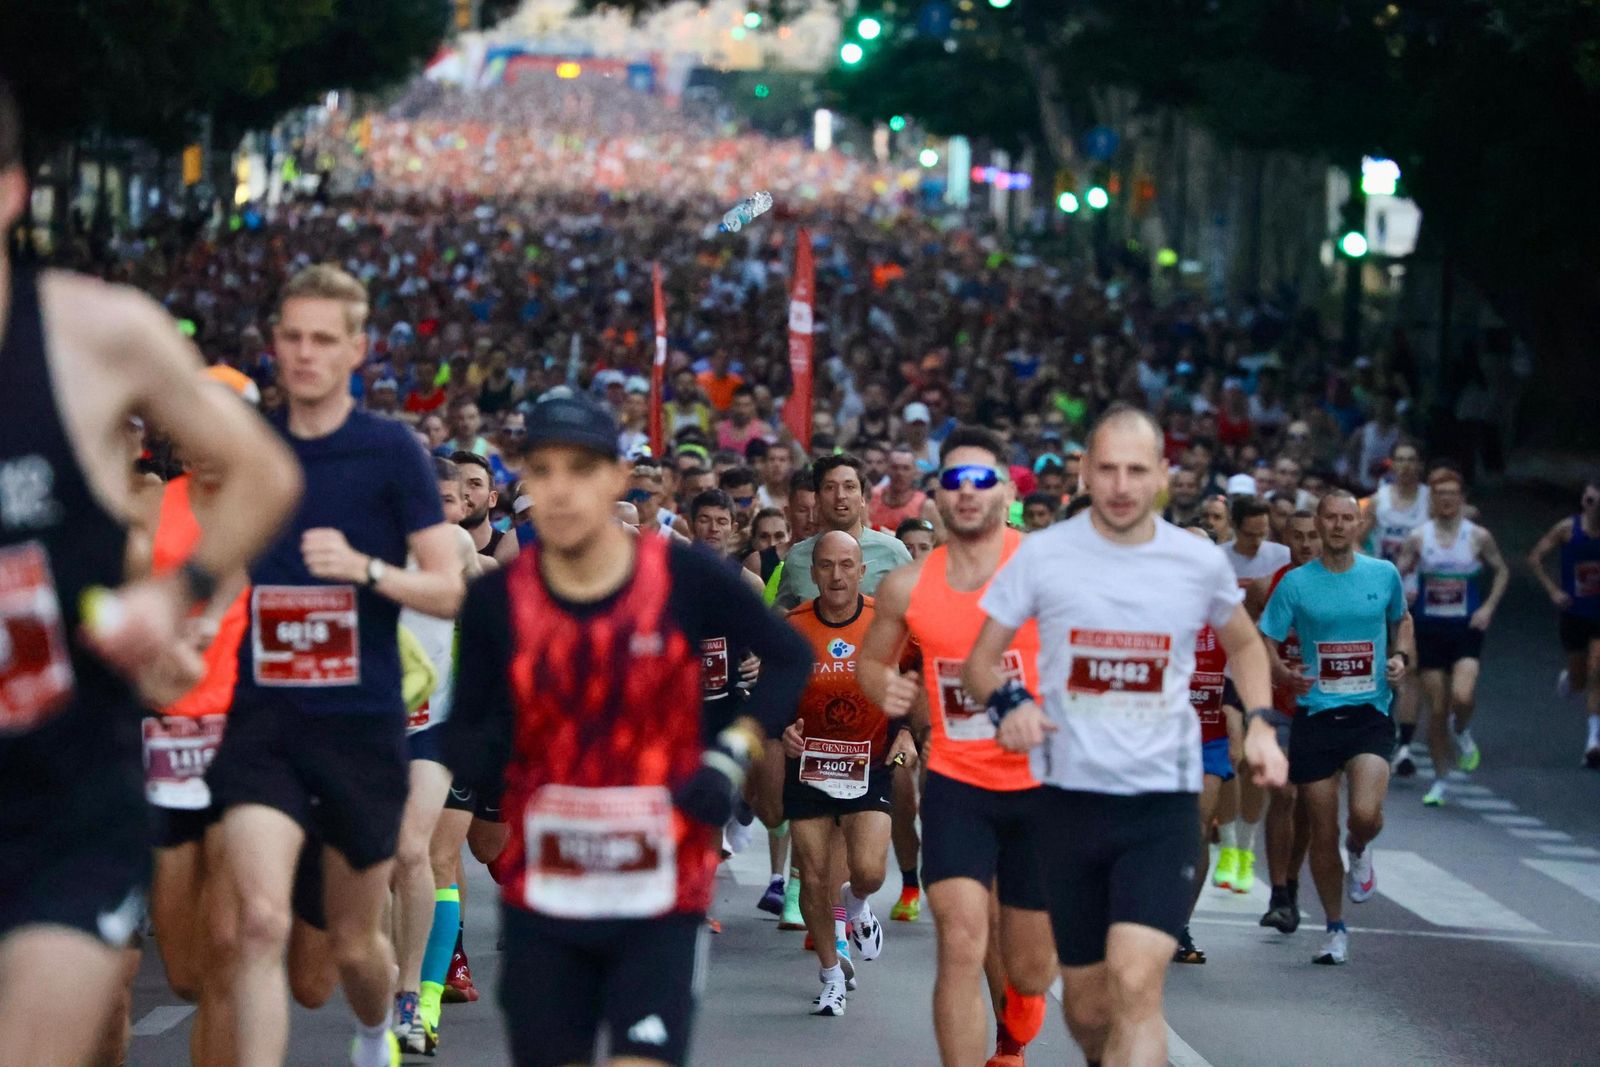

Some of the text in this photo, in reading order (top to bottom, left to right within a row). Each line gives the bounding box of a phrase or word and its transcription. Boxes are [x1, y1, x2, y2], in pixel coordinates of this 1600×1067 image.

[1330, 660, 1364, 672] 12514
[821, 743, 865, 753] GENERALI
[816, 760, 855, 773] 14007
